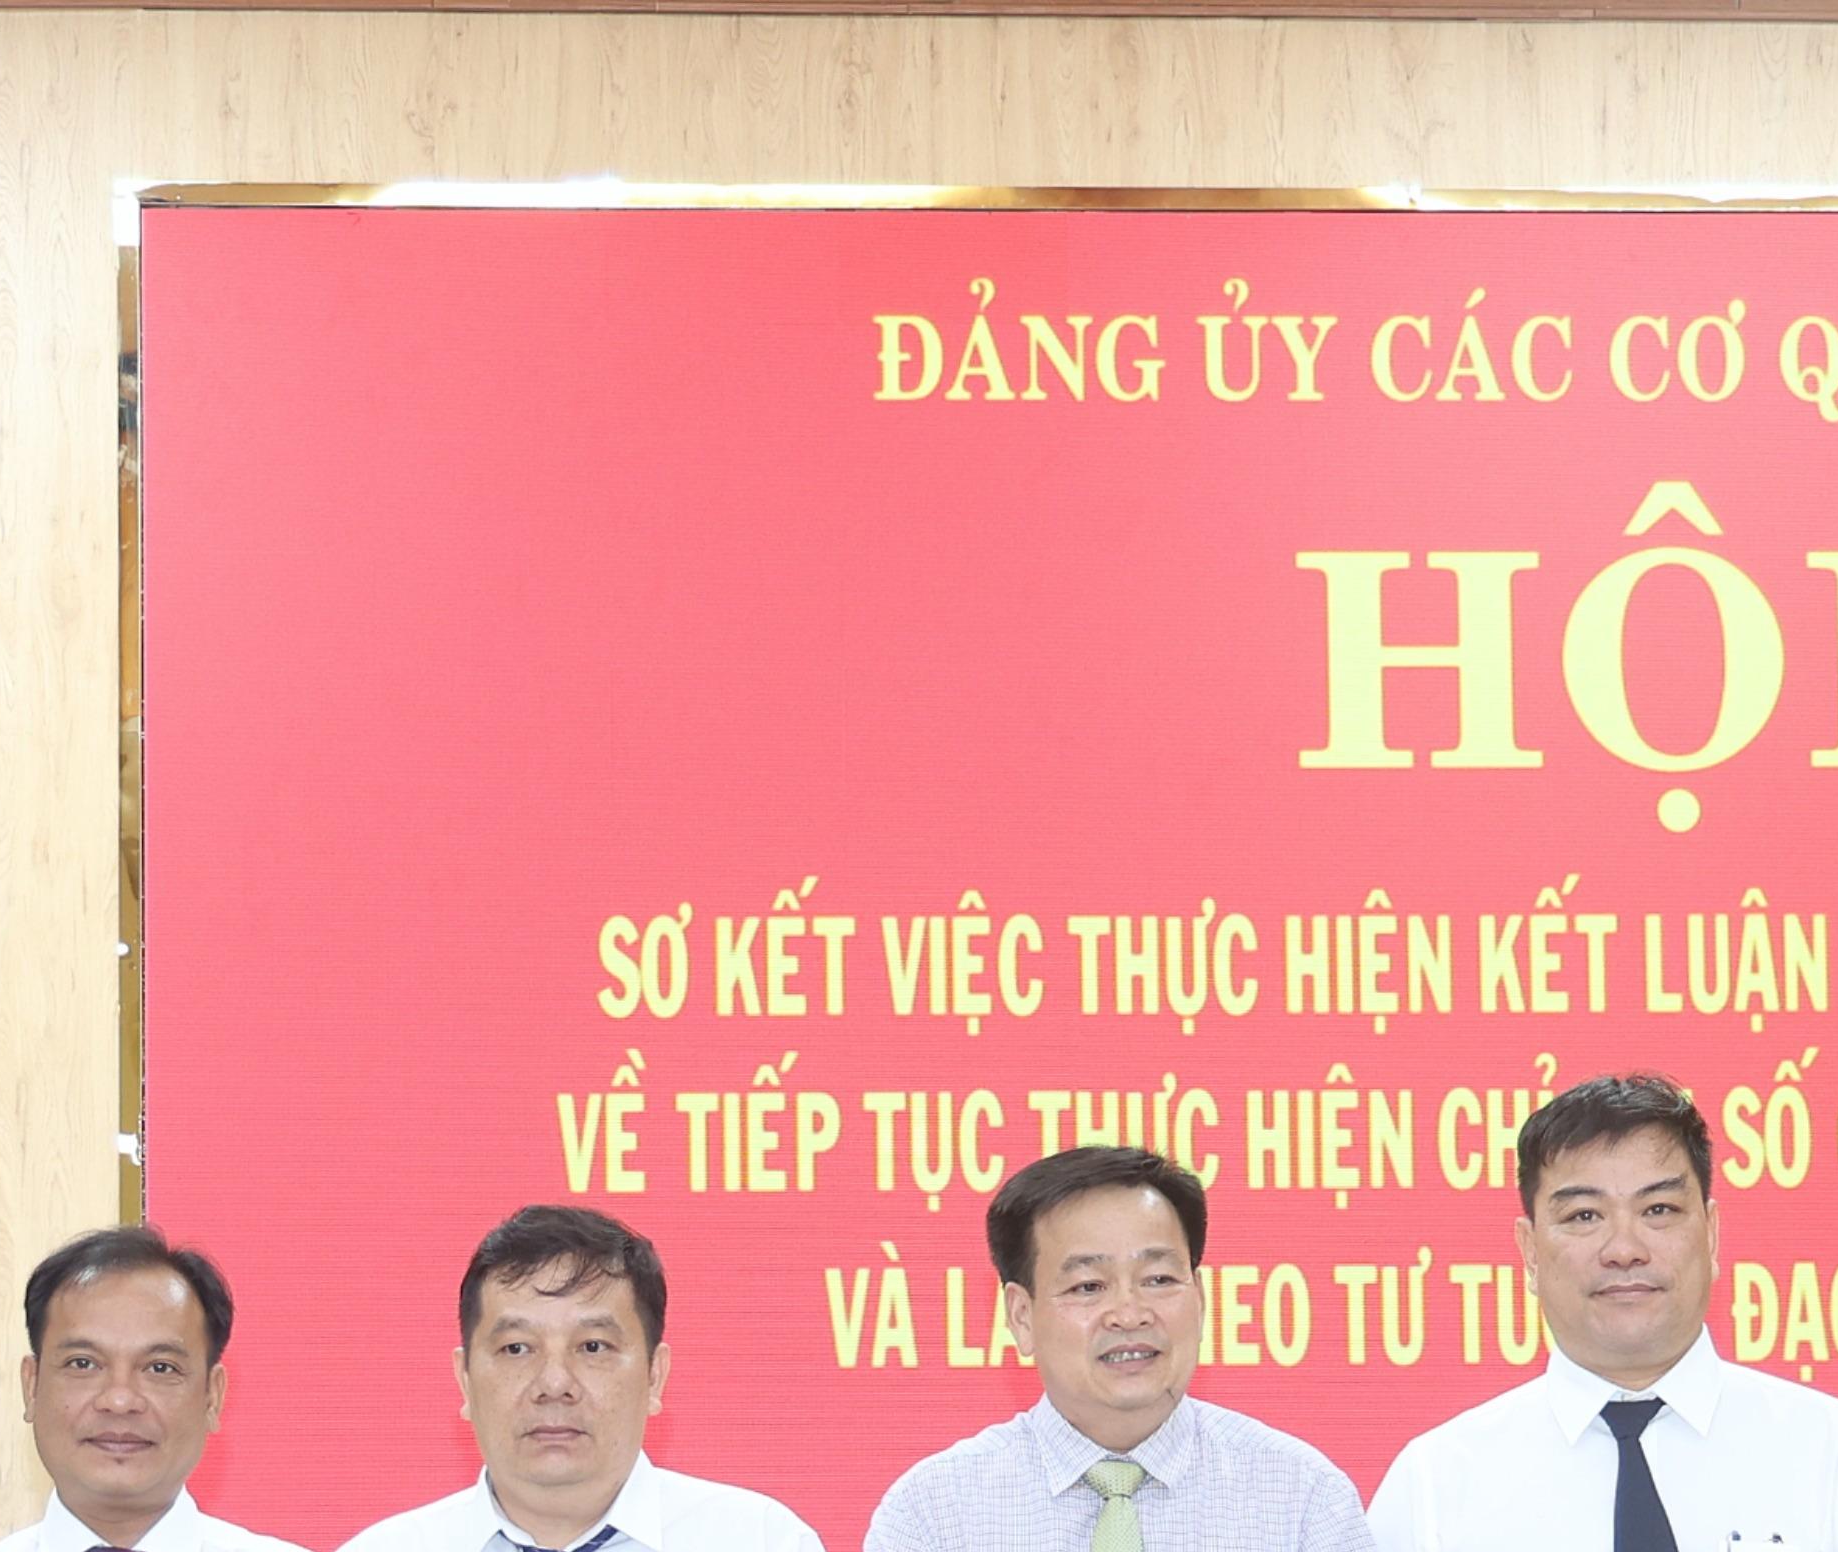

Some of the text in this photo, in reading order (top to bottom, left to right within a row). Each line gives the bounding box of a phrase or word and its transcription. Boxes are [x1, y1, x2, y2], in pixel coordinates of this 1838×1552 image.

[872, 277, 1165, 401] ĐẢNG
[1196, 277, 1338, 401] ỦY
[1370, 288, 1573, 401] CÁC
[1609, 298, 1747, 401] CƠ
[597, 902, 693, 1019] SƠ
[715, 876, 857, 1016] KẾT
[881, 889, 1044, 1035] VIỆC
[1066, 898, 1259, 1035] THỰC
[1284, 887, 1454, 1035] HIỆN
[1478, 873, 1619, 1013] KẾT
[1644, 886, 1829, 1033] LUẬN
[556, 1049, 647, 1193] VỀ
[675, 1052, 842, 1192] TIẾP
[861, 1089, 1005, 1211] TỤC
[1246, 1063, 1414, 1208] HIỆN
[1721, 1046, 1819, 1189] SỐ
[825, 1243, 918, 1368] VÀ
[1332, 1247, 1433, 1365] TƯ
